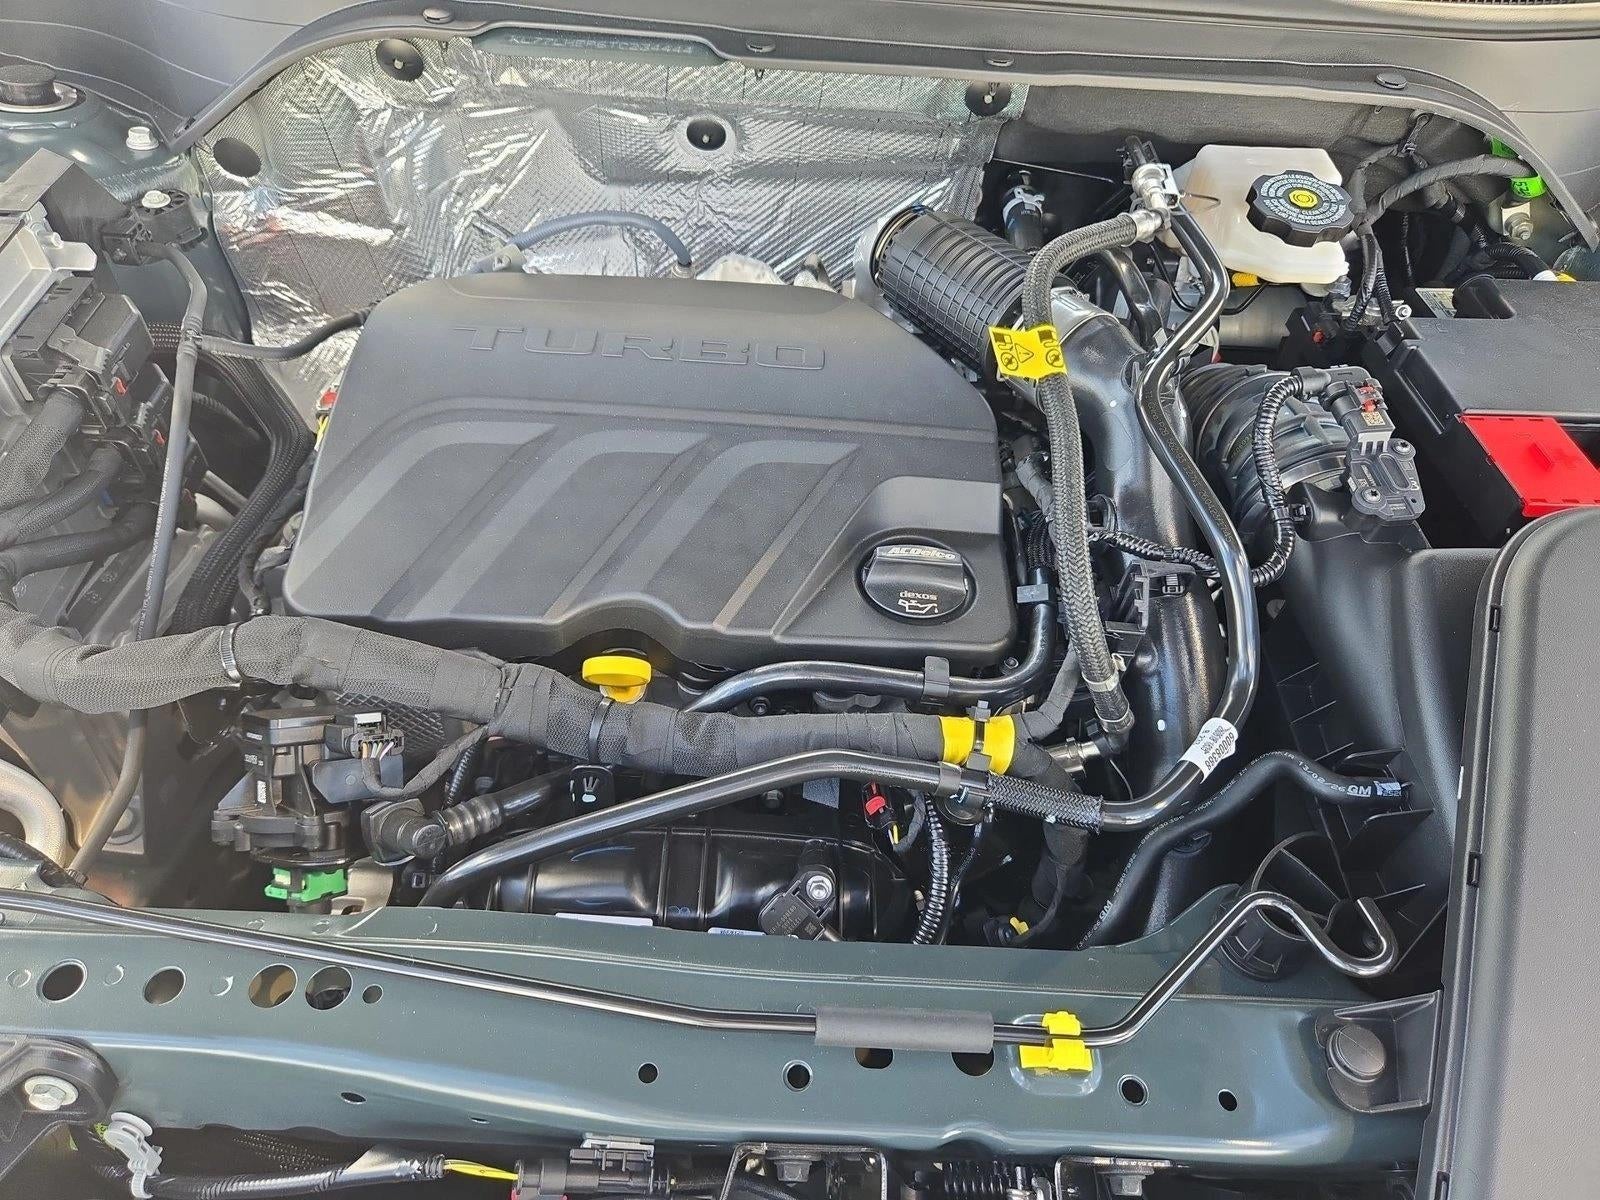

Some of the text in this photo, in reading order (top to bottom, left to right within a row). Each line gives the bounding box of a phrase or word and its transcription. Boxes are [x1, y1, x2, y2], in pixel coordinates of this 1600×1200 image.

[454, 327, 825, 370] TURBO
[887, 547, 956, 559] ACDelco
[899, 590, 938, 600] dexos
[1347, 784, 1371, 797] GM
